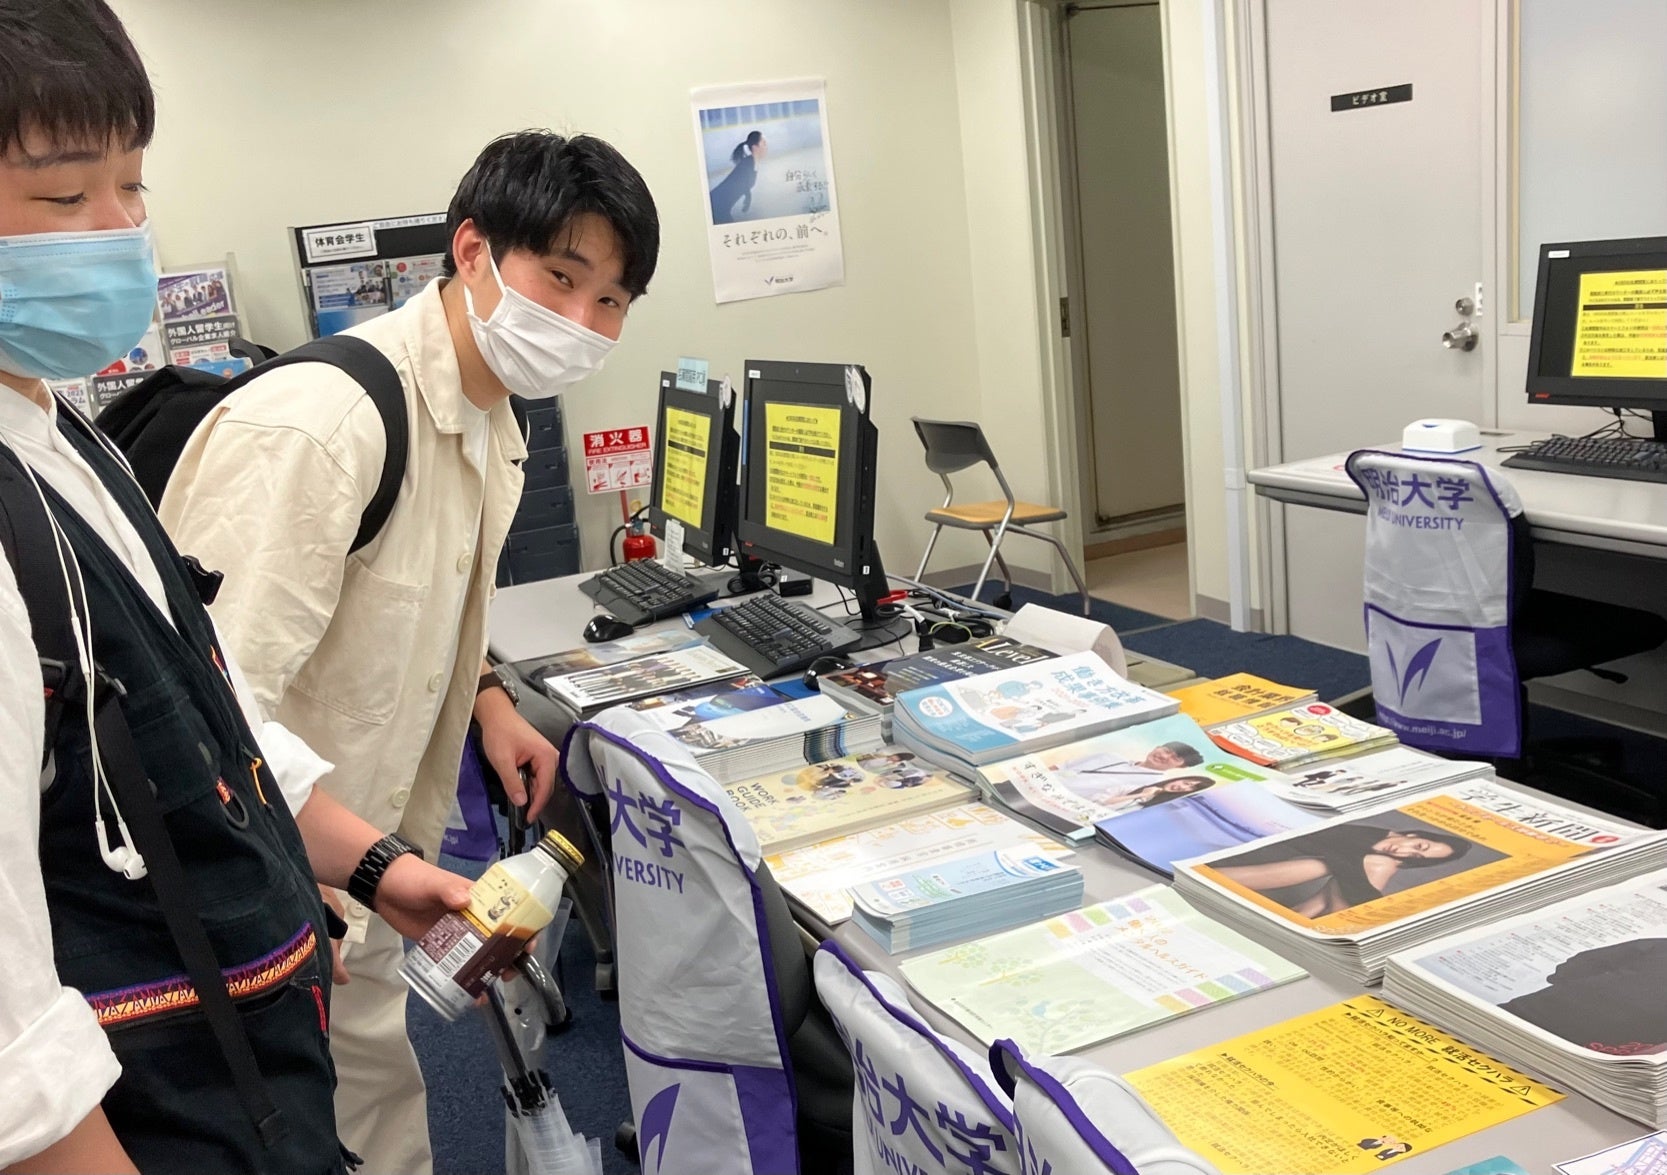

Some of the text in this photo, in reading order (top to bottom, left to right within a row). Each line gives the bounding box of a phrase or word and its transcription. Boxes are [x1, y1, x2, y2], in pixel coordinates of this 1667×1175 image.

[315, 232, 366, 248] 体育会学生
[722, 225, 829, 248] それぞれの、前へ。
[589, 429, 643, 448] 消火器
[1361, 467, 1474, 510] 明治大学
[1391, 512, 1464, 530] UNIVERSITY
[737, 785, 767, 808] GUIDE
[751, 782, 779, 805] WORK
[601, 765, 685, 858] 大学
[1387, 1017, 1515, 1083] NO MORE 就活セクハラ
[832, 1010, 1008, 1175] 治大学
